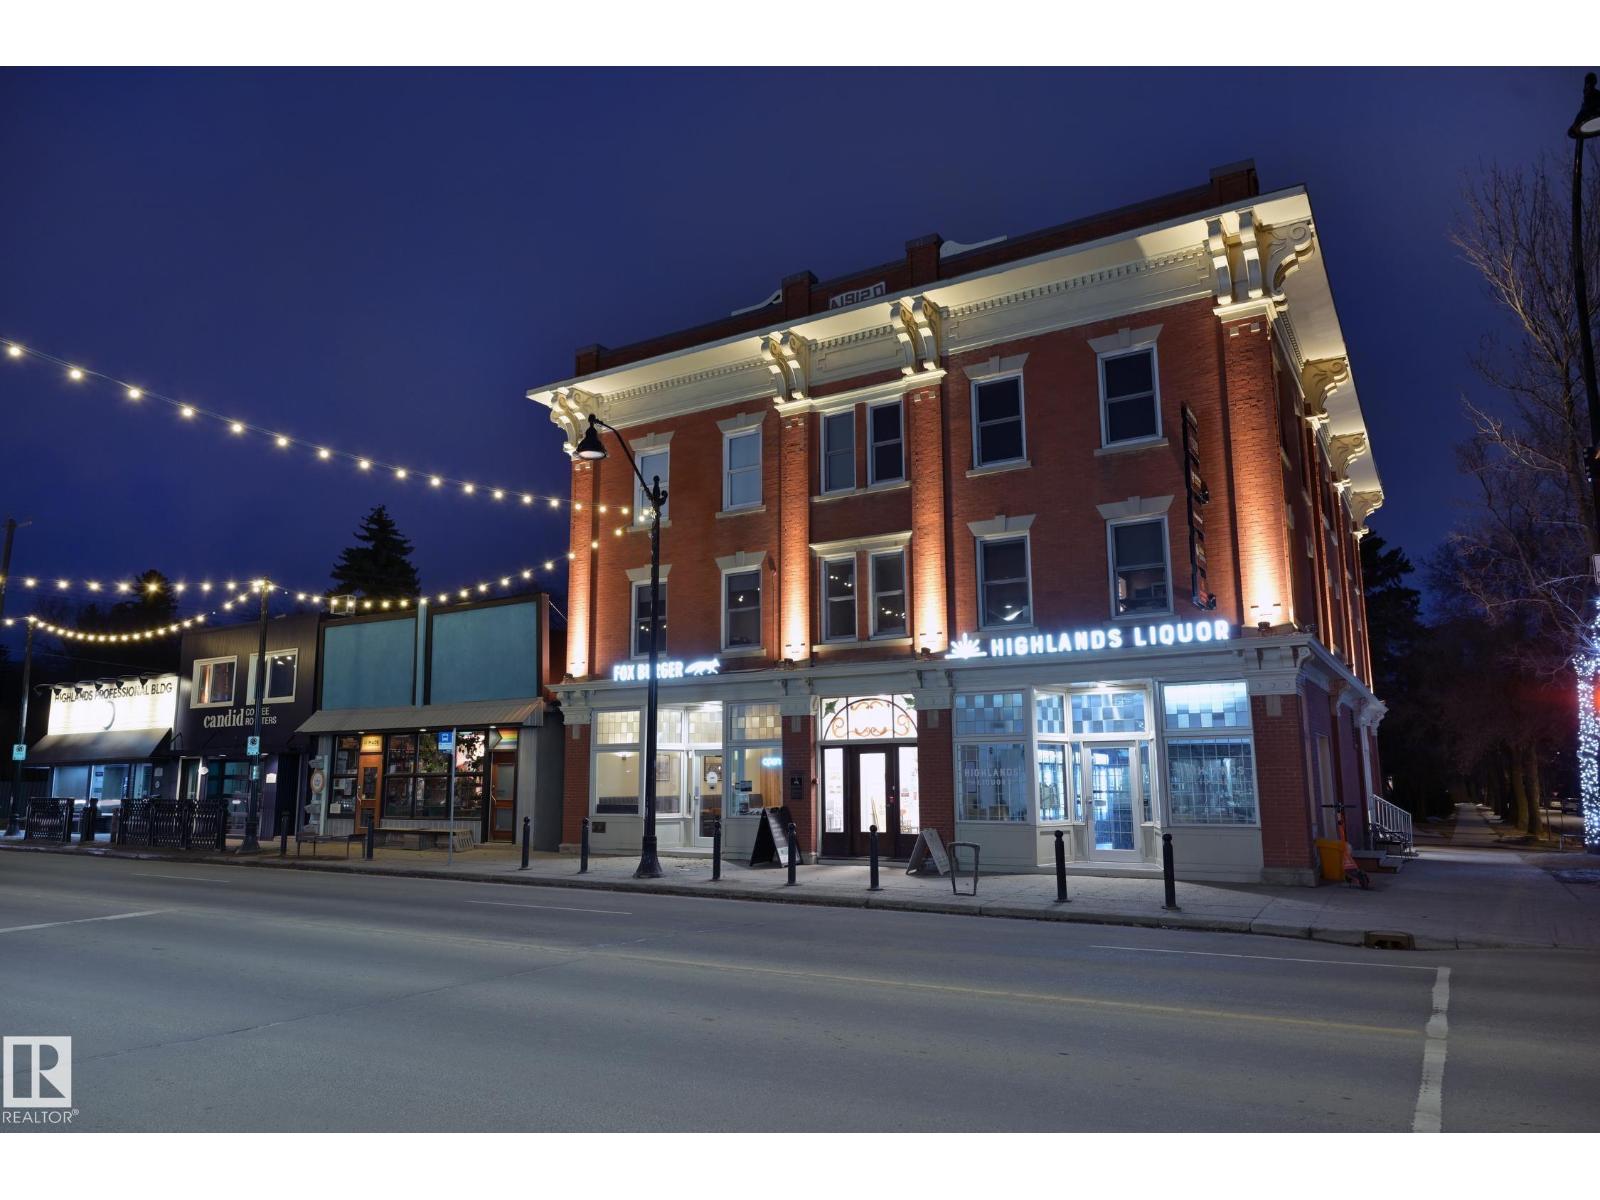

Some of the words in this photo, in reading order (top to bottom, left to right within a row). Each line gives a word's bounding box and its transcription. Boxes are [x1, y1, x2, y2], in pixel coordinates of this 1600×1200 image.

[990, 628, 1123, 657] HIGHLANDS
[1133, 619, 1230, 647] LIQUOR
[613, 664, 635, 682] FOX
[151, 682, 173, 695] BLDG
[203, 708, 245, 729] candid
[245, 707, 270, 716] COEE
[245, 716, 277, 726] ROTERS
